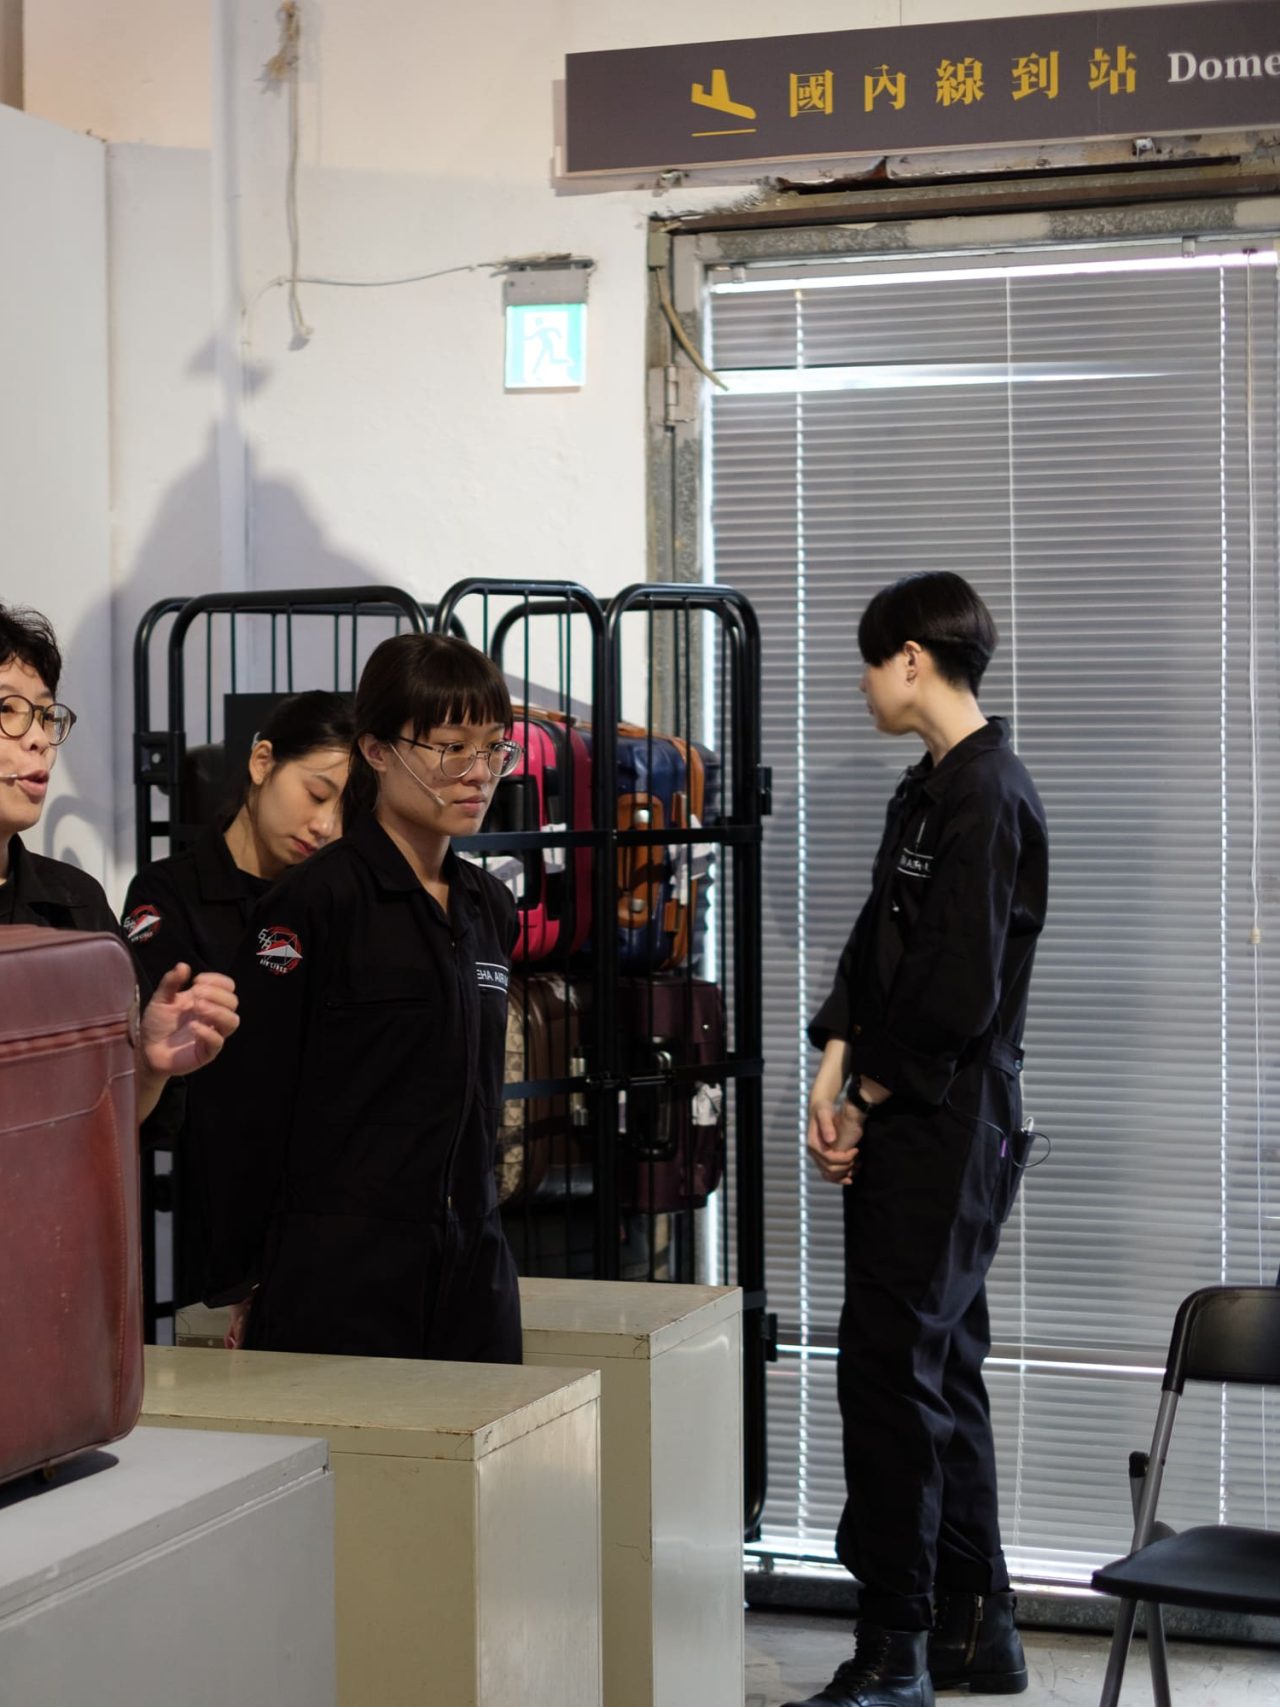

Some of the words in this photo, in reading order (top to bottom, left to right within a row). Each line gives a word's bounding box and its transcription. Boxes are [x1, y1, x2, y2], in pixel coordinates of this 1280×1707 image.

[789, 45, 1137, 118] 國內線到站
[1167, 52, 1280, 83] Dome
